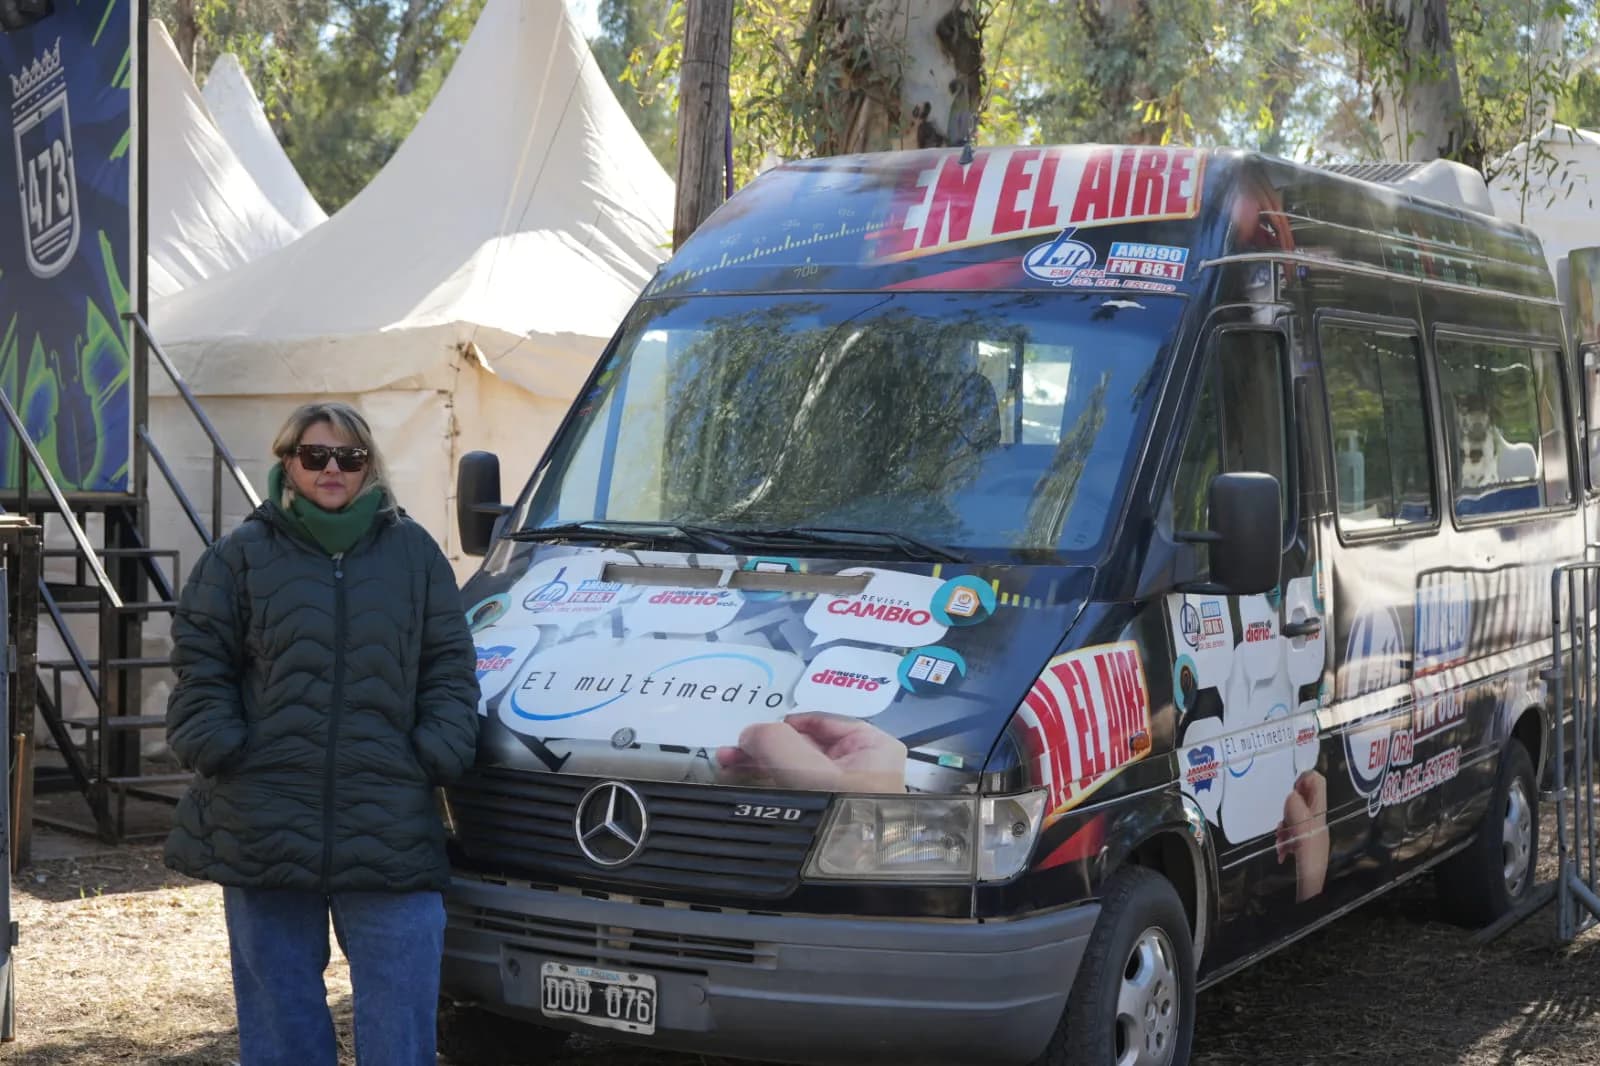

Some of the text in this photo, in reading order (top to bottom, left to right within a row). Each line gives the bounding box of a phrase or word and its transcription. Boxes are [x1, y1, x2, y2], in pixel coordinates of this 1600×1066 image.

[28, 139, 70, 233] 473
[878, 149, 1194, 255] EN EL AIRE
[1115, 244, 1182, 262] AM890
[1110, 260, 1179, 278] FM 88.1
[649, 591, 718, 606] diario
[861, 594, 910, 606] REVISTA
[827, 599, 931, 626] CAMBIO
[1245, 623, 1270, 643] diario
[521, 671, 784, 709] El multimedio
[811, 669, 880, 692] diario
[1050, 659, 1107, 790] EL
[1094, 649, 1146, 769] AIRE
[734, 803, 779, 820] 312
[605, 984, 650, 1022] 076
